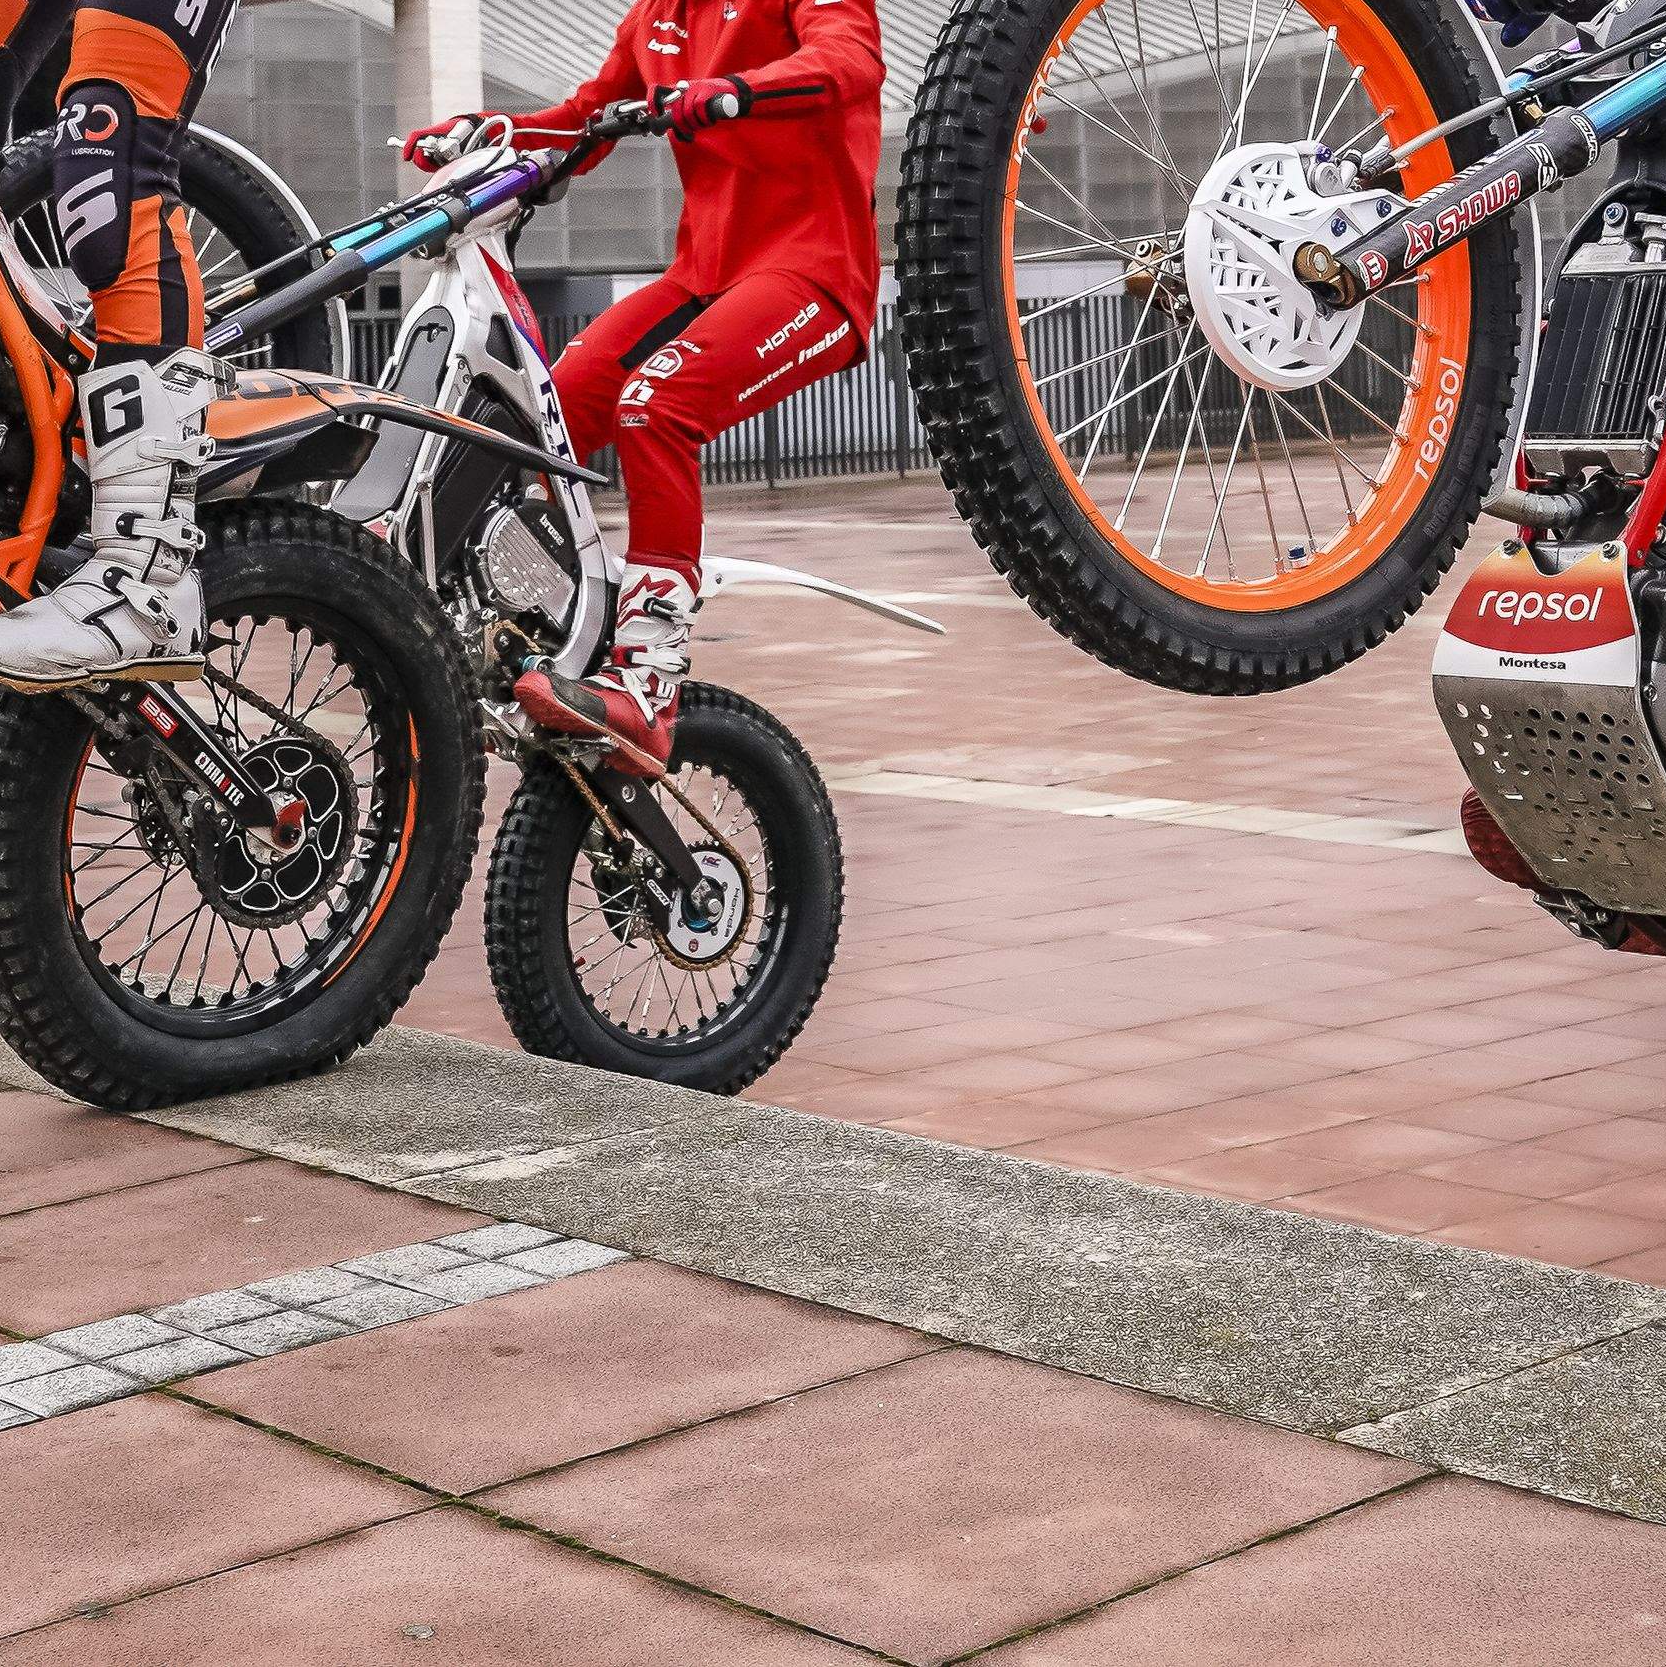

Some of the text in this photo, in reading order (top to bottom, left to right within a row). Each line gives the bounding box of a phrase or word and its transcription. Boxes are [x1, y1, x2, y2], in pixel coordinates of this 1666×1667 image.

[1436, 169, 1523, 246] SHOWA
[736, 360, 795, 403] Montesa
[1414, 356, 1464, 482] repsol
[1476, 586, 1605, 627] repsol
[1498, 656, 1568, 671] Montesa
